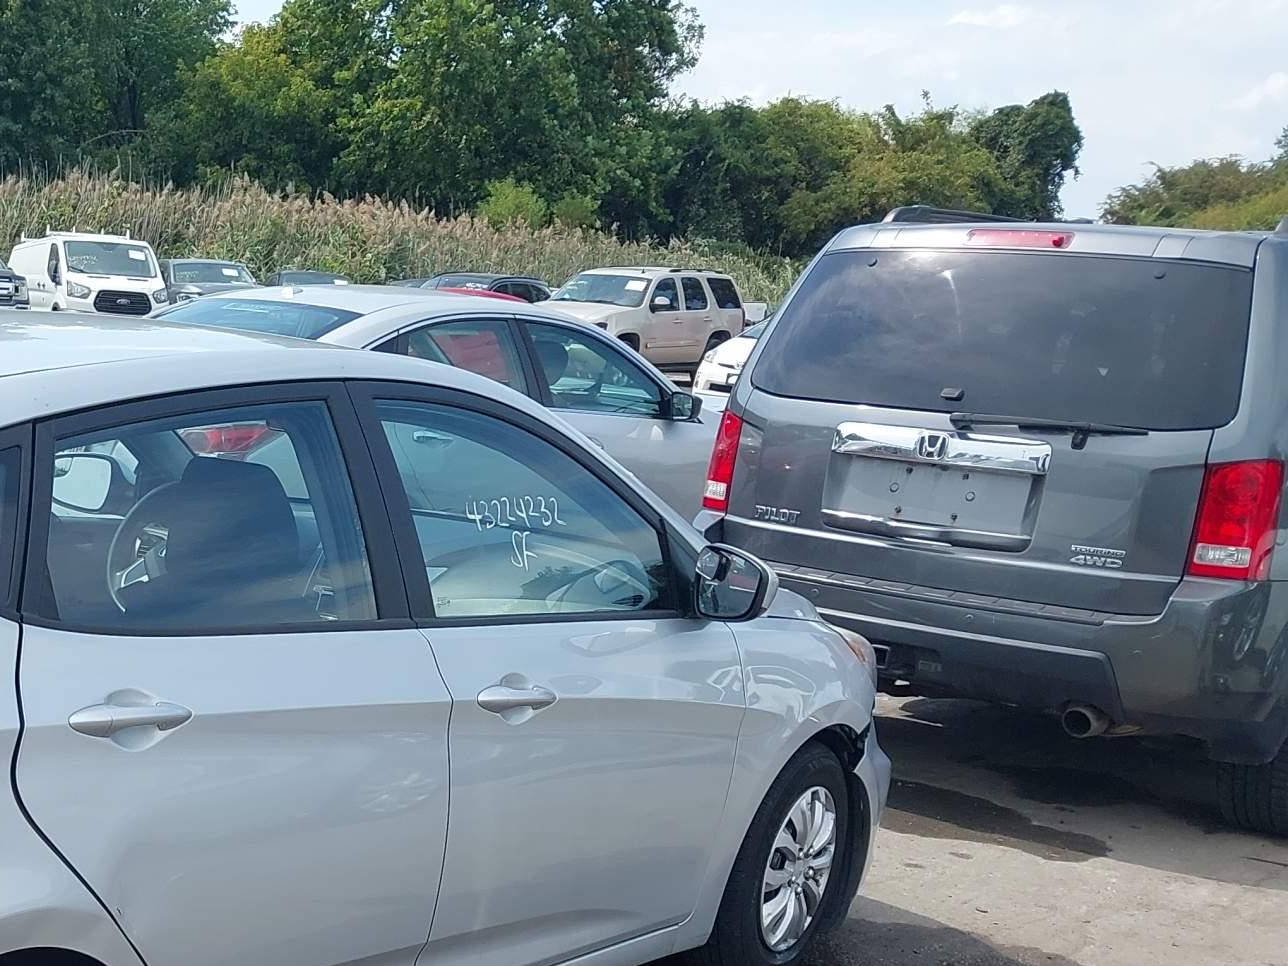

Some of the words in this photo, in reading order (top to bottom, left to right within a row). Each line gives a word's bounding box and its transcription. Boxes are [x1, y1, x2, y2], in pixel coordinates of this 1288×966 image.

[465, 495, 567, 531] 43224232
[754, 504, 801, 523] PILOT
[1072, 545, 1126, 558] TOURING
[1069, 554, 1123, 568] 4WD
